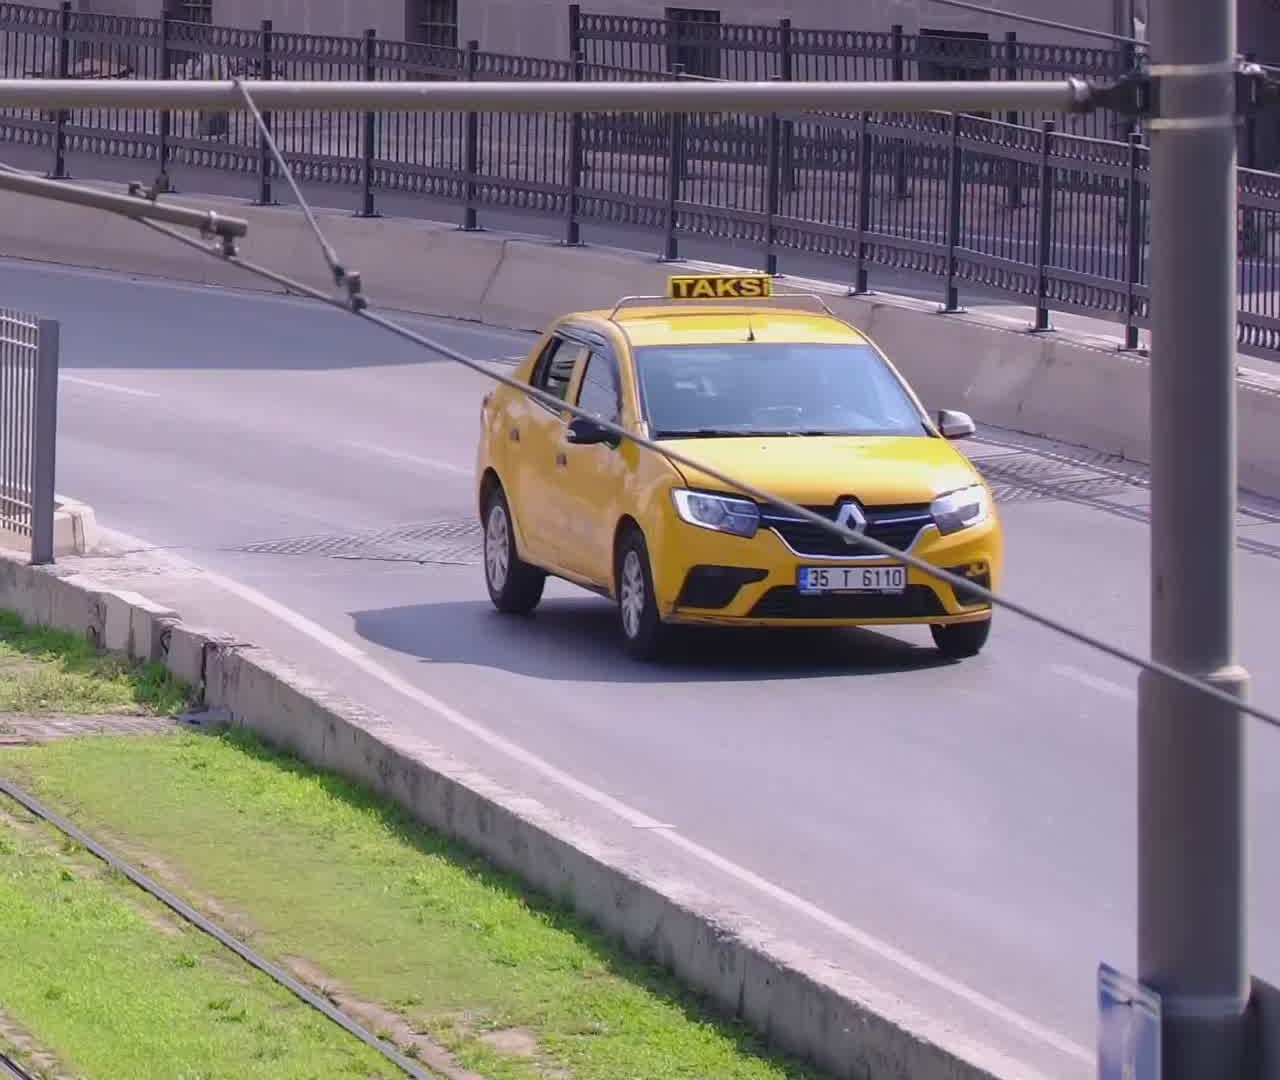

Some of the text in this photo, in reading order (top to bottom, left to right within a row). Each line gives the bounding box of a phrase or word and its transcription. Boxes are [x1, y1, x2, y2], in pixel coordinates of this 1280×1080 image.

[810, 569, 902, 587] 35 T 6110
